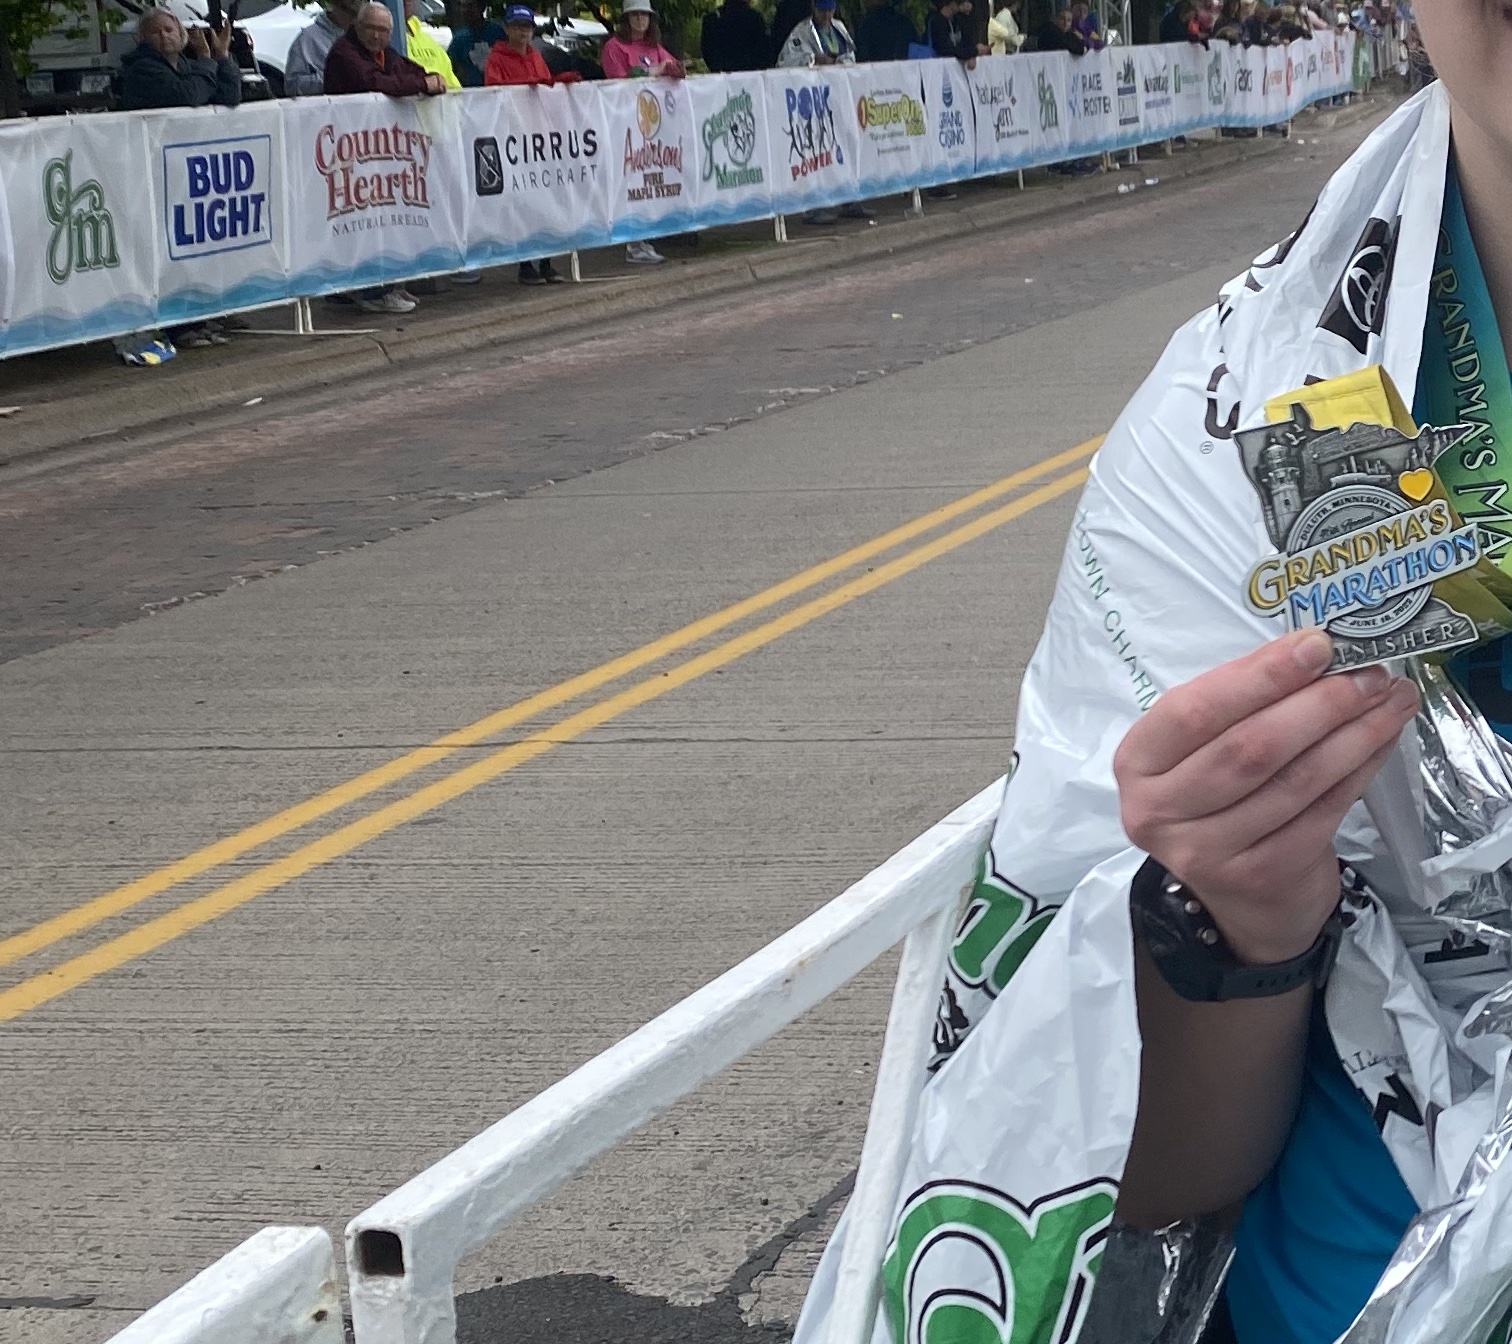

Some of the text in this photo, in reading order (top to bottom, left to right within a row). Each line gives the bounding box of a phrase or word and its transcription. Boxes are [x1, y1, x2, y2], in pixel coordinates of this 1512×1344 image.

[314, 122, 433, 178] Country
[505, 128, 598, 165] CIRRUS
[186, 150, 255, 198] BUD
[326, 162, 431, 221] Hearth
[512, 164, 598, 192] AIRCRAFT
[173, 192, 266, 246] LIGHT
[332, 213, 430, 237] NATURAL BREADS
[1249, 502, 1450, 610] GRANDMA'S
[1289, 529, 1477, 632] MARATHON
[1334, 622, 1456, 665] INISHER
